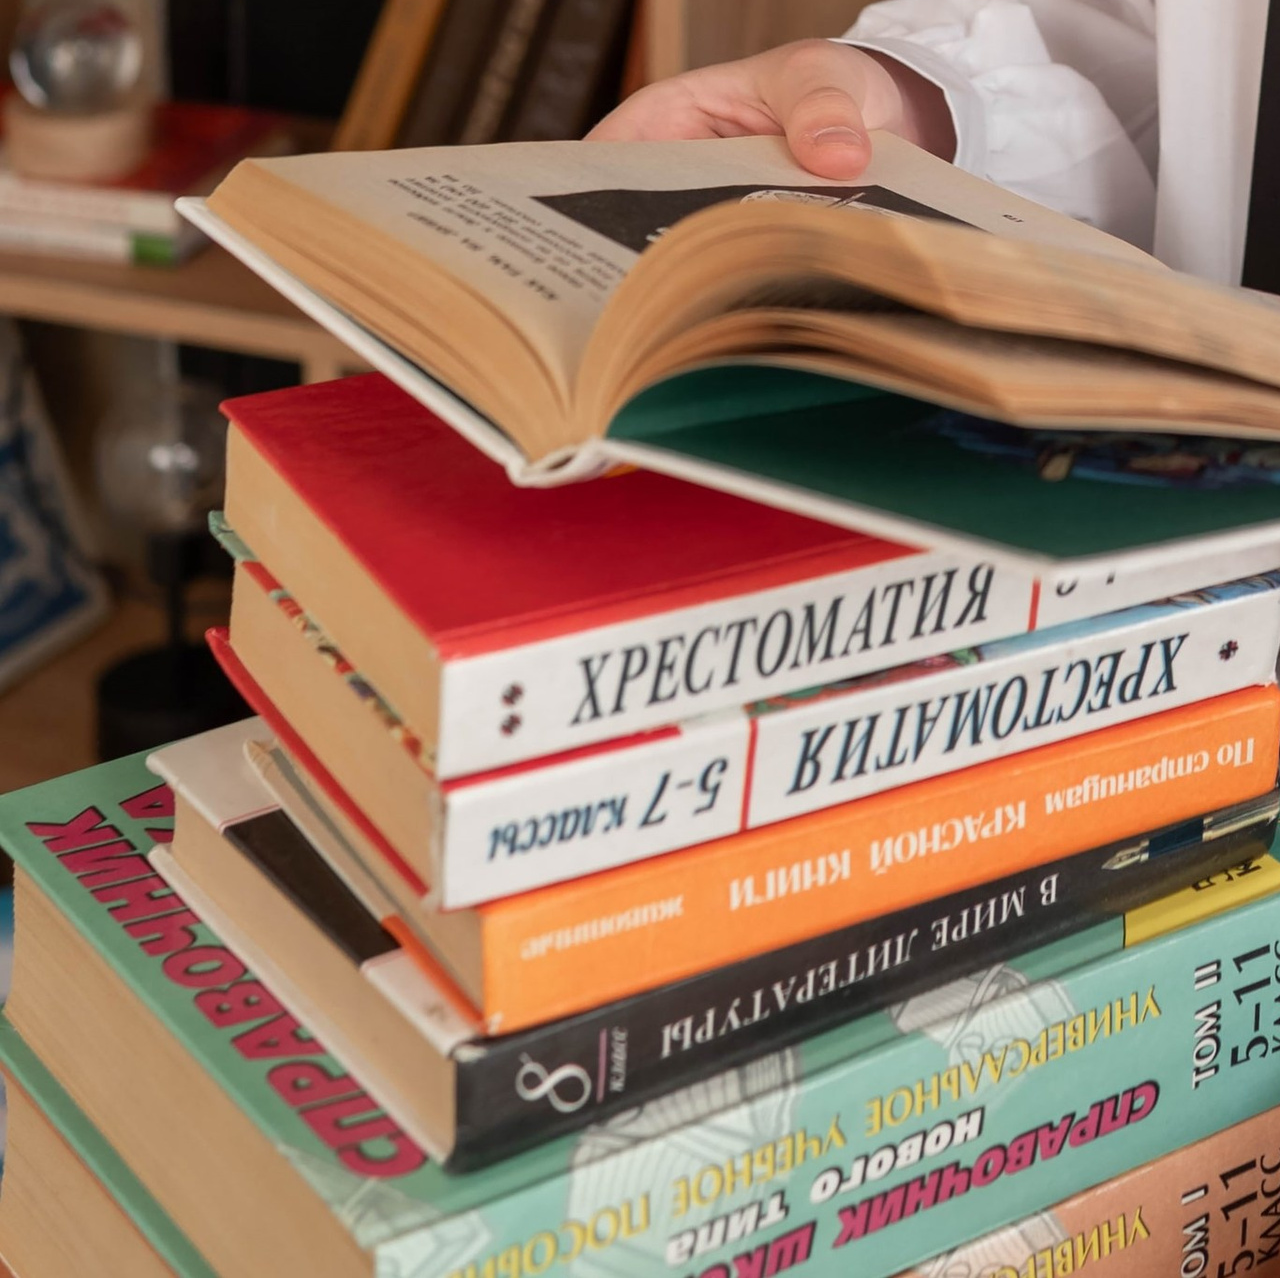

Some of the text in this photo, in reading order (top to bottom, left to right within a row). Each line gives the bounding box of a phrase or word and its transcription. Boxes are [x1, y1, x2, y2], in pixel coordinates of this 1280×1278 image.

[570, 561, 996, 726] ХРЕСТОМАТИЯ
[785, 633, 1190, 796] ХРЕСТОМАТИЯ
[488, 755, 730, 862] 5-7 классы
[729, 736, 1255, 911] По страницам КРАСНОЙ КНИГИ
[26, 804, 429, 1180] СПРАВОЧНИК
[660, 872, 1060, 1061] В МИРЕ ЛИТЕРАТУРЫ
[1192, 999, 1222, 1091] ТОМ
[1230, 943, 1272, 1068] 5-11
[863, 984, 1162, 1138] УНИВЕРСАЛЬНОЕ
[672, 1115, 848, 1218] УЧЕБНОЕ
[832, 1079, 1161, 1251] СПРАВОЧНИК
